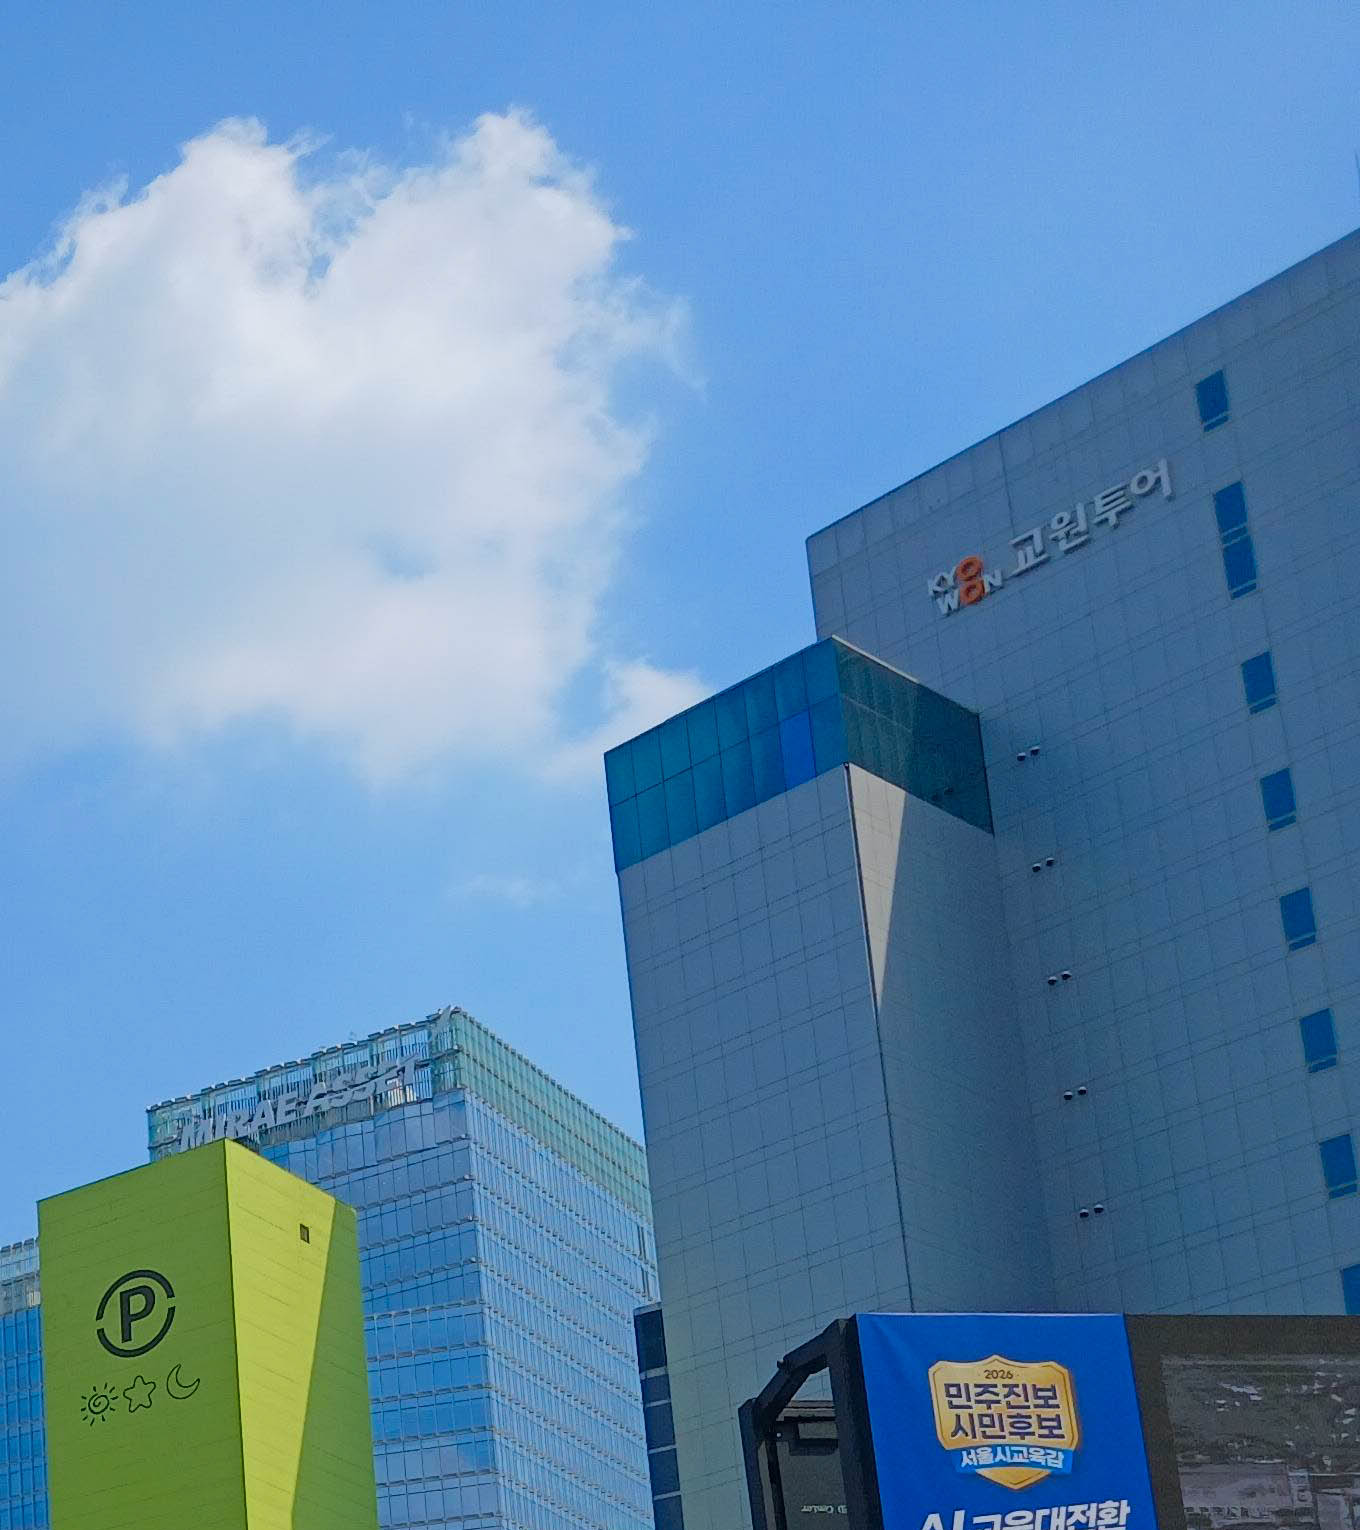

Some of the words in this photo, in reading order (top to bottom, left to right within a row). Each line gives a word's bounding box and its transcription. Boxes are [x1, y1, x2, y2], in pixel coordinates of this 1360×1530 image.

[1007, 458, 1173, 578] 교원투어
[119, 1284, 156, 1344] P
[983, 1369, 1013, 1380] 2026
[943, 1382, 1061, 1411] 민주진보
[950, 1412, 1065, 1441] 시민후보
[960, 1447, 1065, 1470] 서울시교육감
